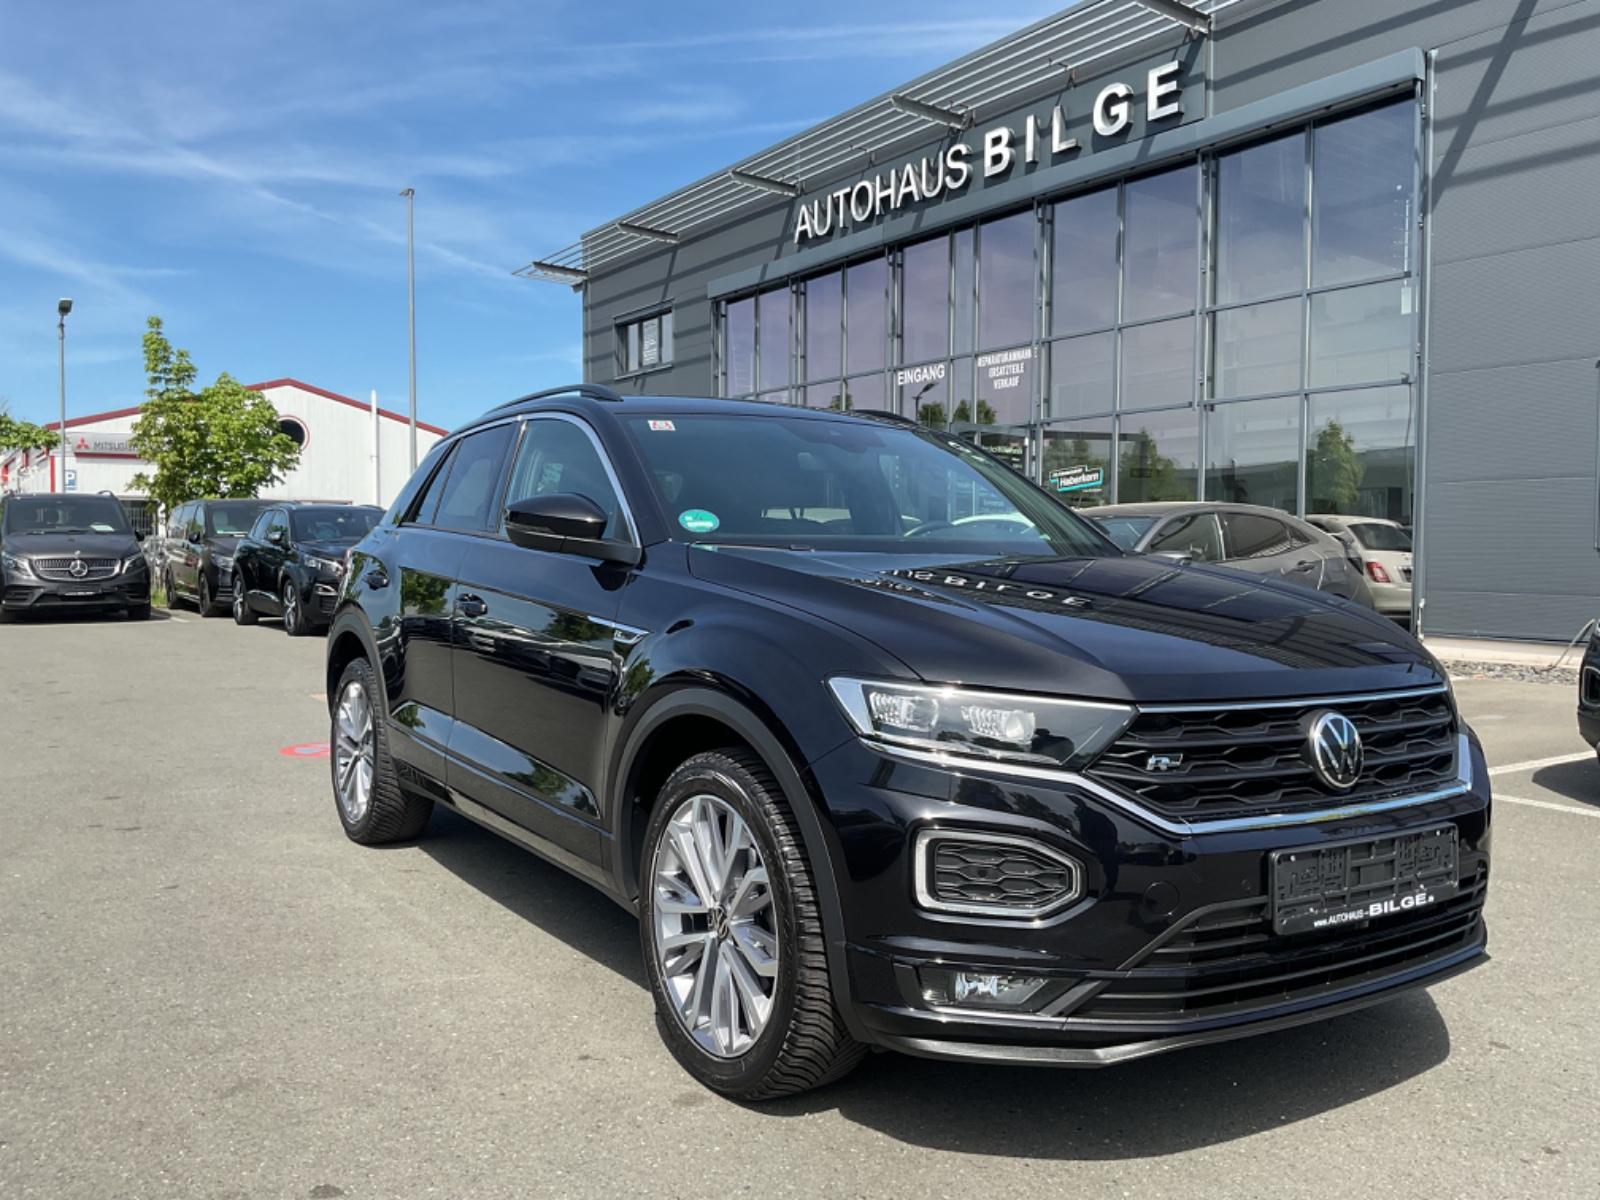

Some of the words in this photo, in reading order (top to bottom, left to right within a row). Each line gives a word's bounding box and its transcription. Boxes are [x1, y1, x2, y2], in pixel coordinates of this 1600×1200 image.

[794, 144, 969, 244] AUTOHAUS
[984, 60, 1182, 178] BILGE
[898, 364, 945, 386] EINGANG
[988, 362, 1025, 378] ERSATZTEILE
[993, 376, 1020, 390] VERKAUF
